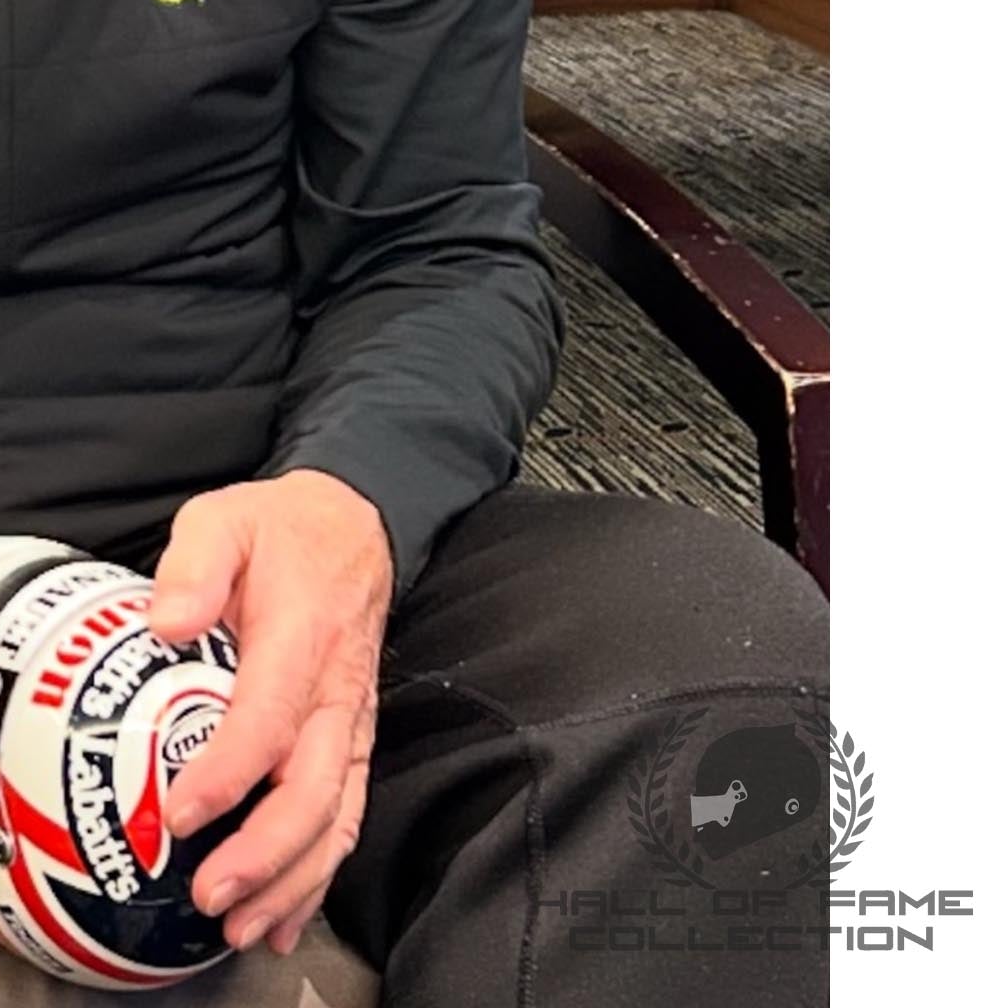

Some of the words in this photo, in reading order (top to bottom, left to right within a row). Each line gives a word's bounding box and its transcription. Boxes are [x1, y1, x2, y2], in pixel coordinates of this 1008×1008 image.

[31, 598, 152, 709] anon
[80, 630, 179, 719] batt's
[174, 722, 216, 762] rai
[69, 734, 140, 902] Labatt's
